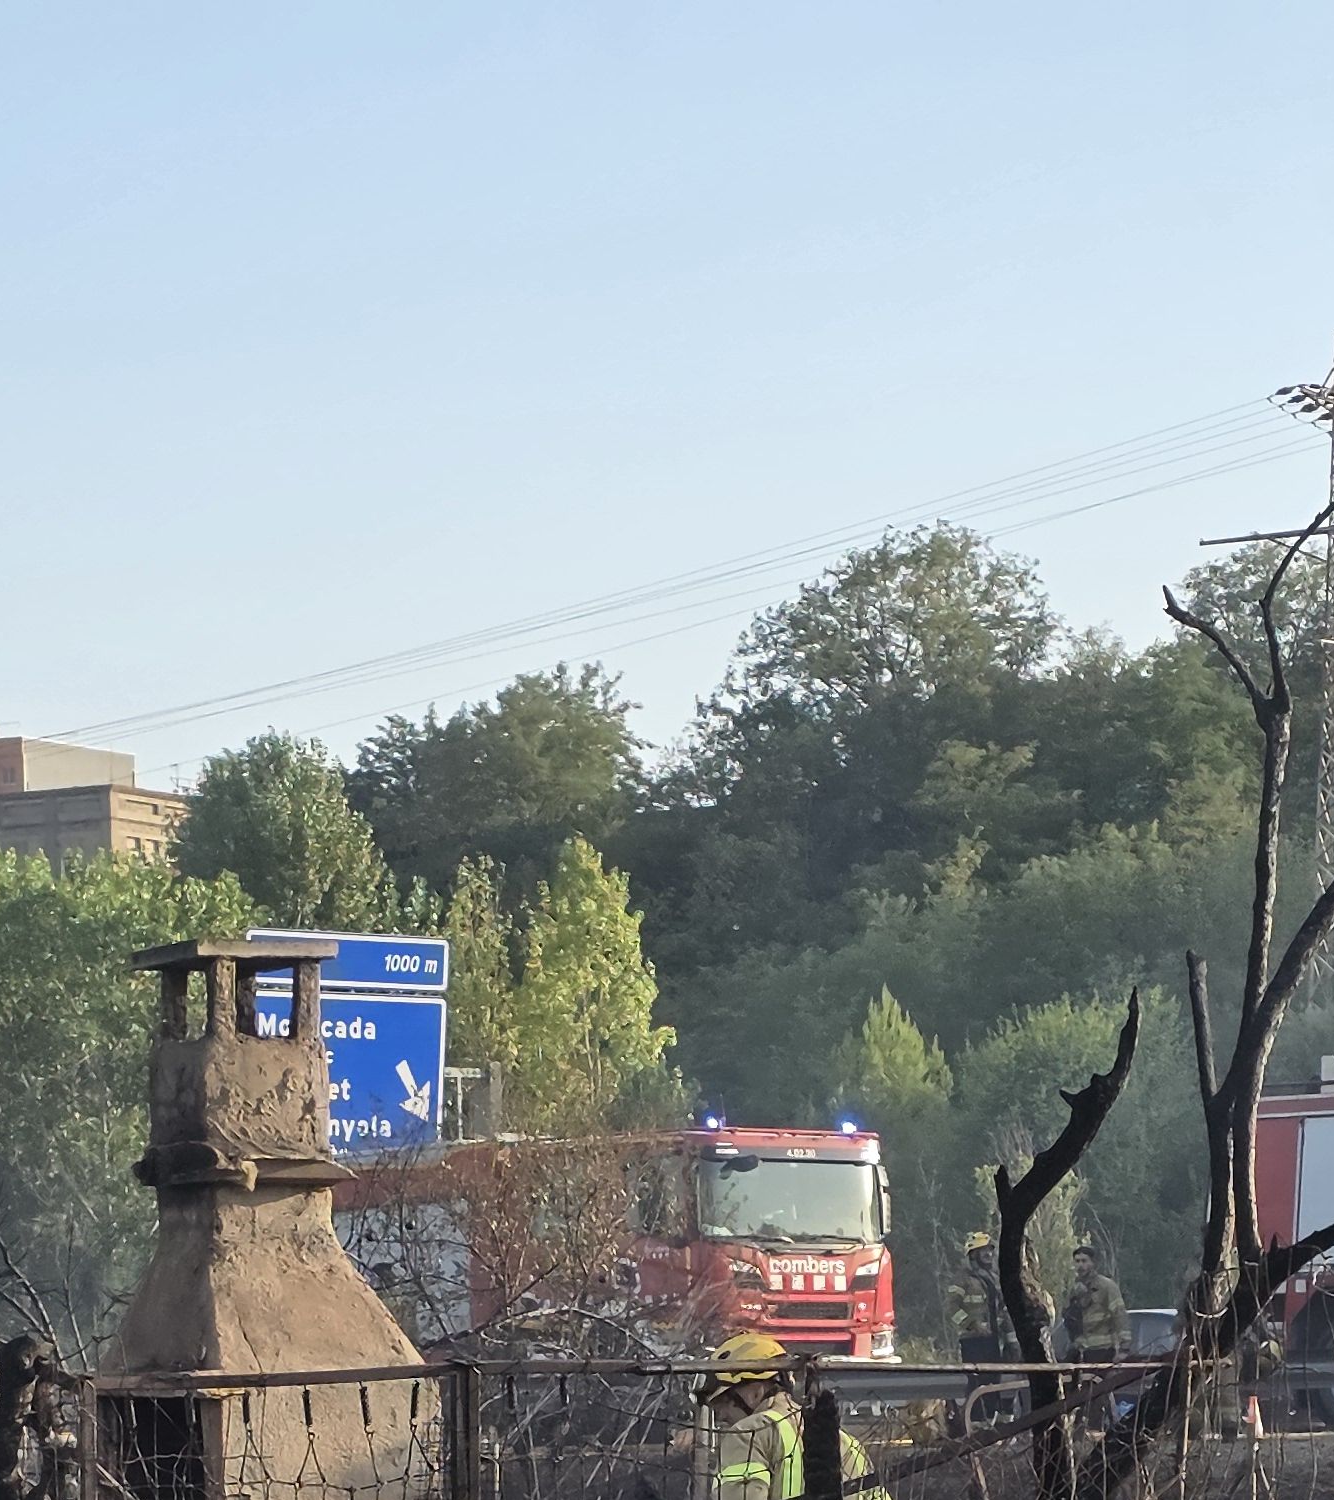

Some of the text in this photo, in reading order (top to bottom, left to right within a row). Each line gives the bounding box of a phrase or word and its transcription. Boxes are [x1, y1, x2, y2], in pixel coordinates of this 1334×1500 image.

[384, 954, 438, 974] 1000 m
[257, 1012, 377, 1040] Mocada
[328, 1114, 392, 1142] nyola
[769, 1255, 846, 1274] bombers
